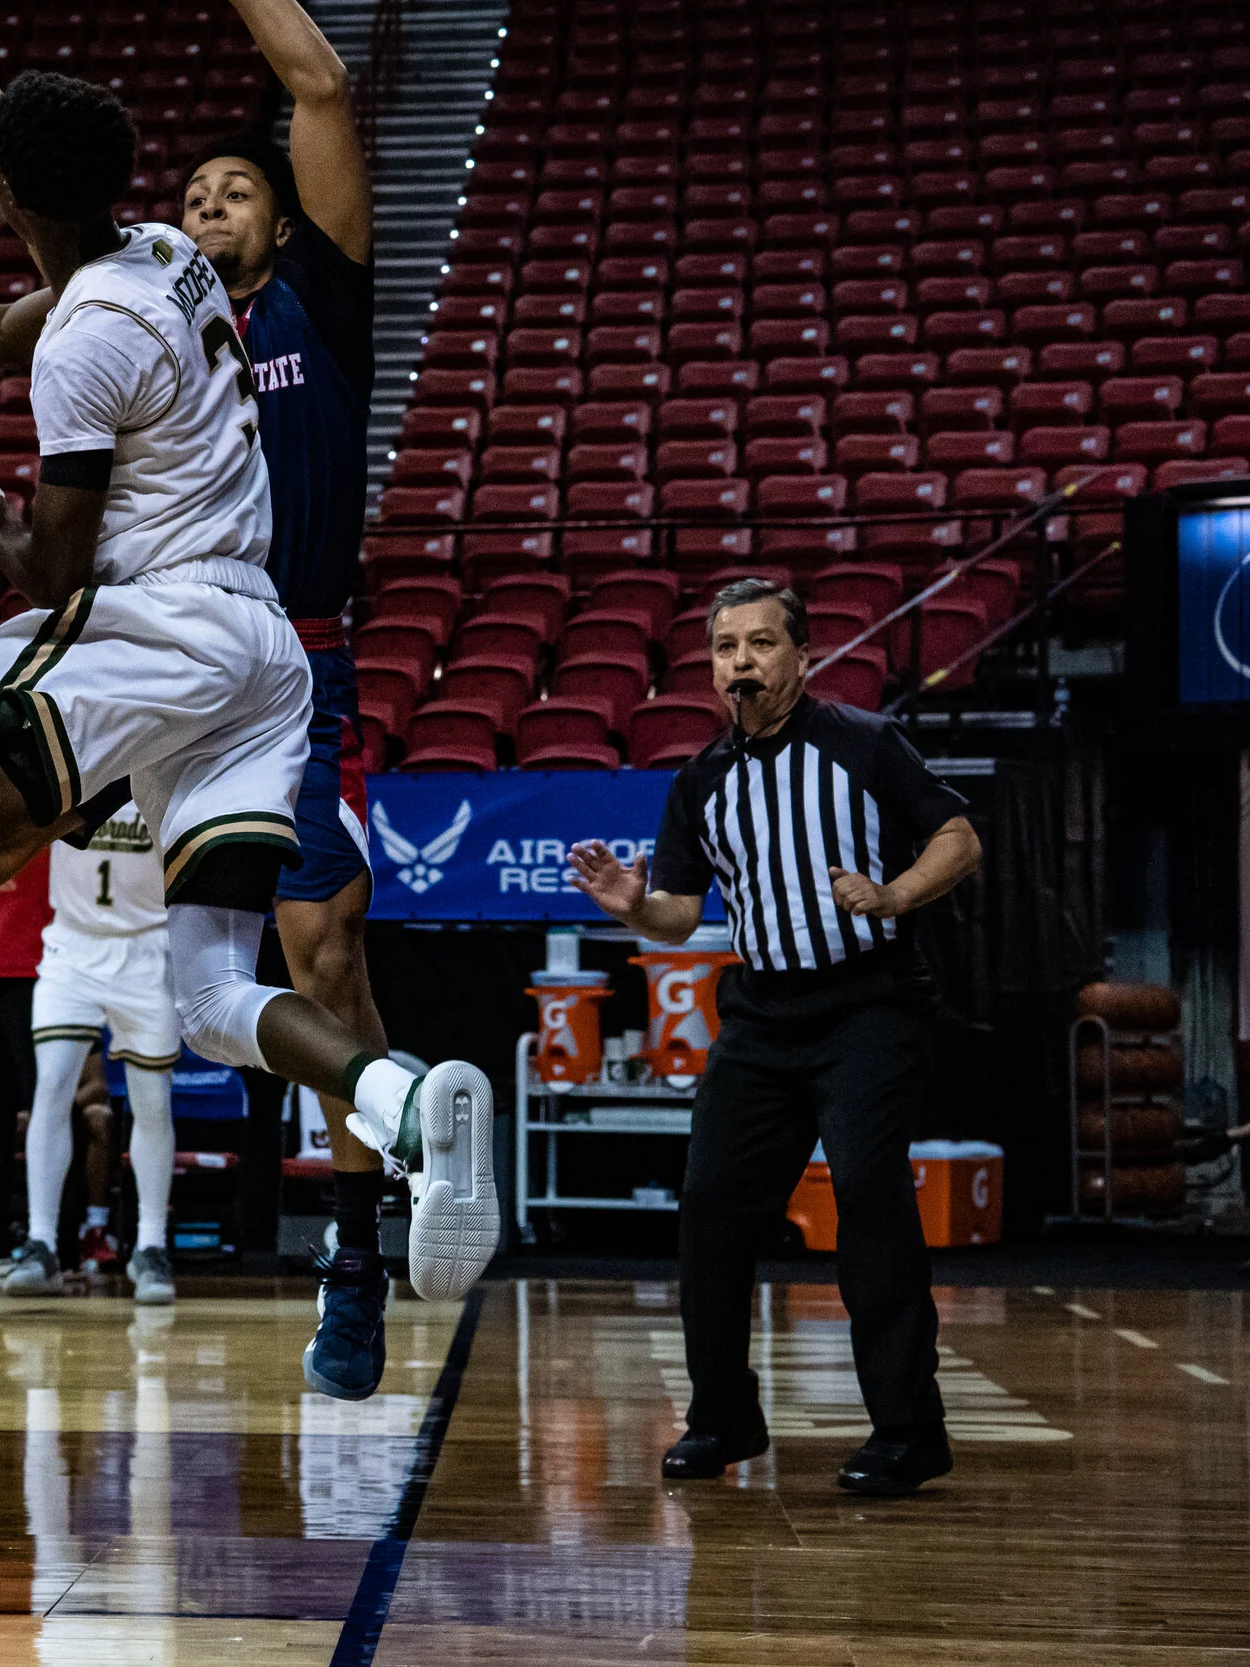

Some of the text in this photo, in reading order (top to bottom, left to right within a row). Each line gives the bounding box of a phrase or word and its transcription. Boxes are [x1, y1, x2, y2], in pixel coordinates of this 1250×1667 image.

[252, 352, 305, 393] TATE
[486, 839, 567, 865] AIR
[96, 861, 113, 904] 1
